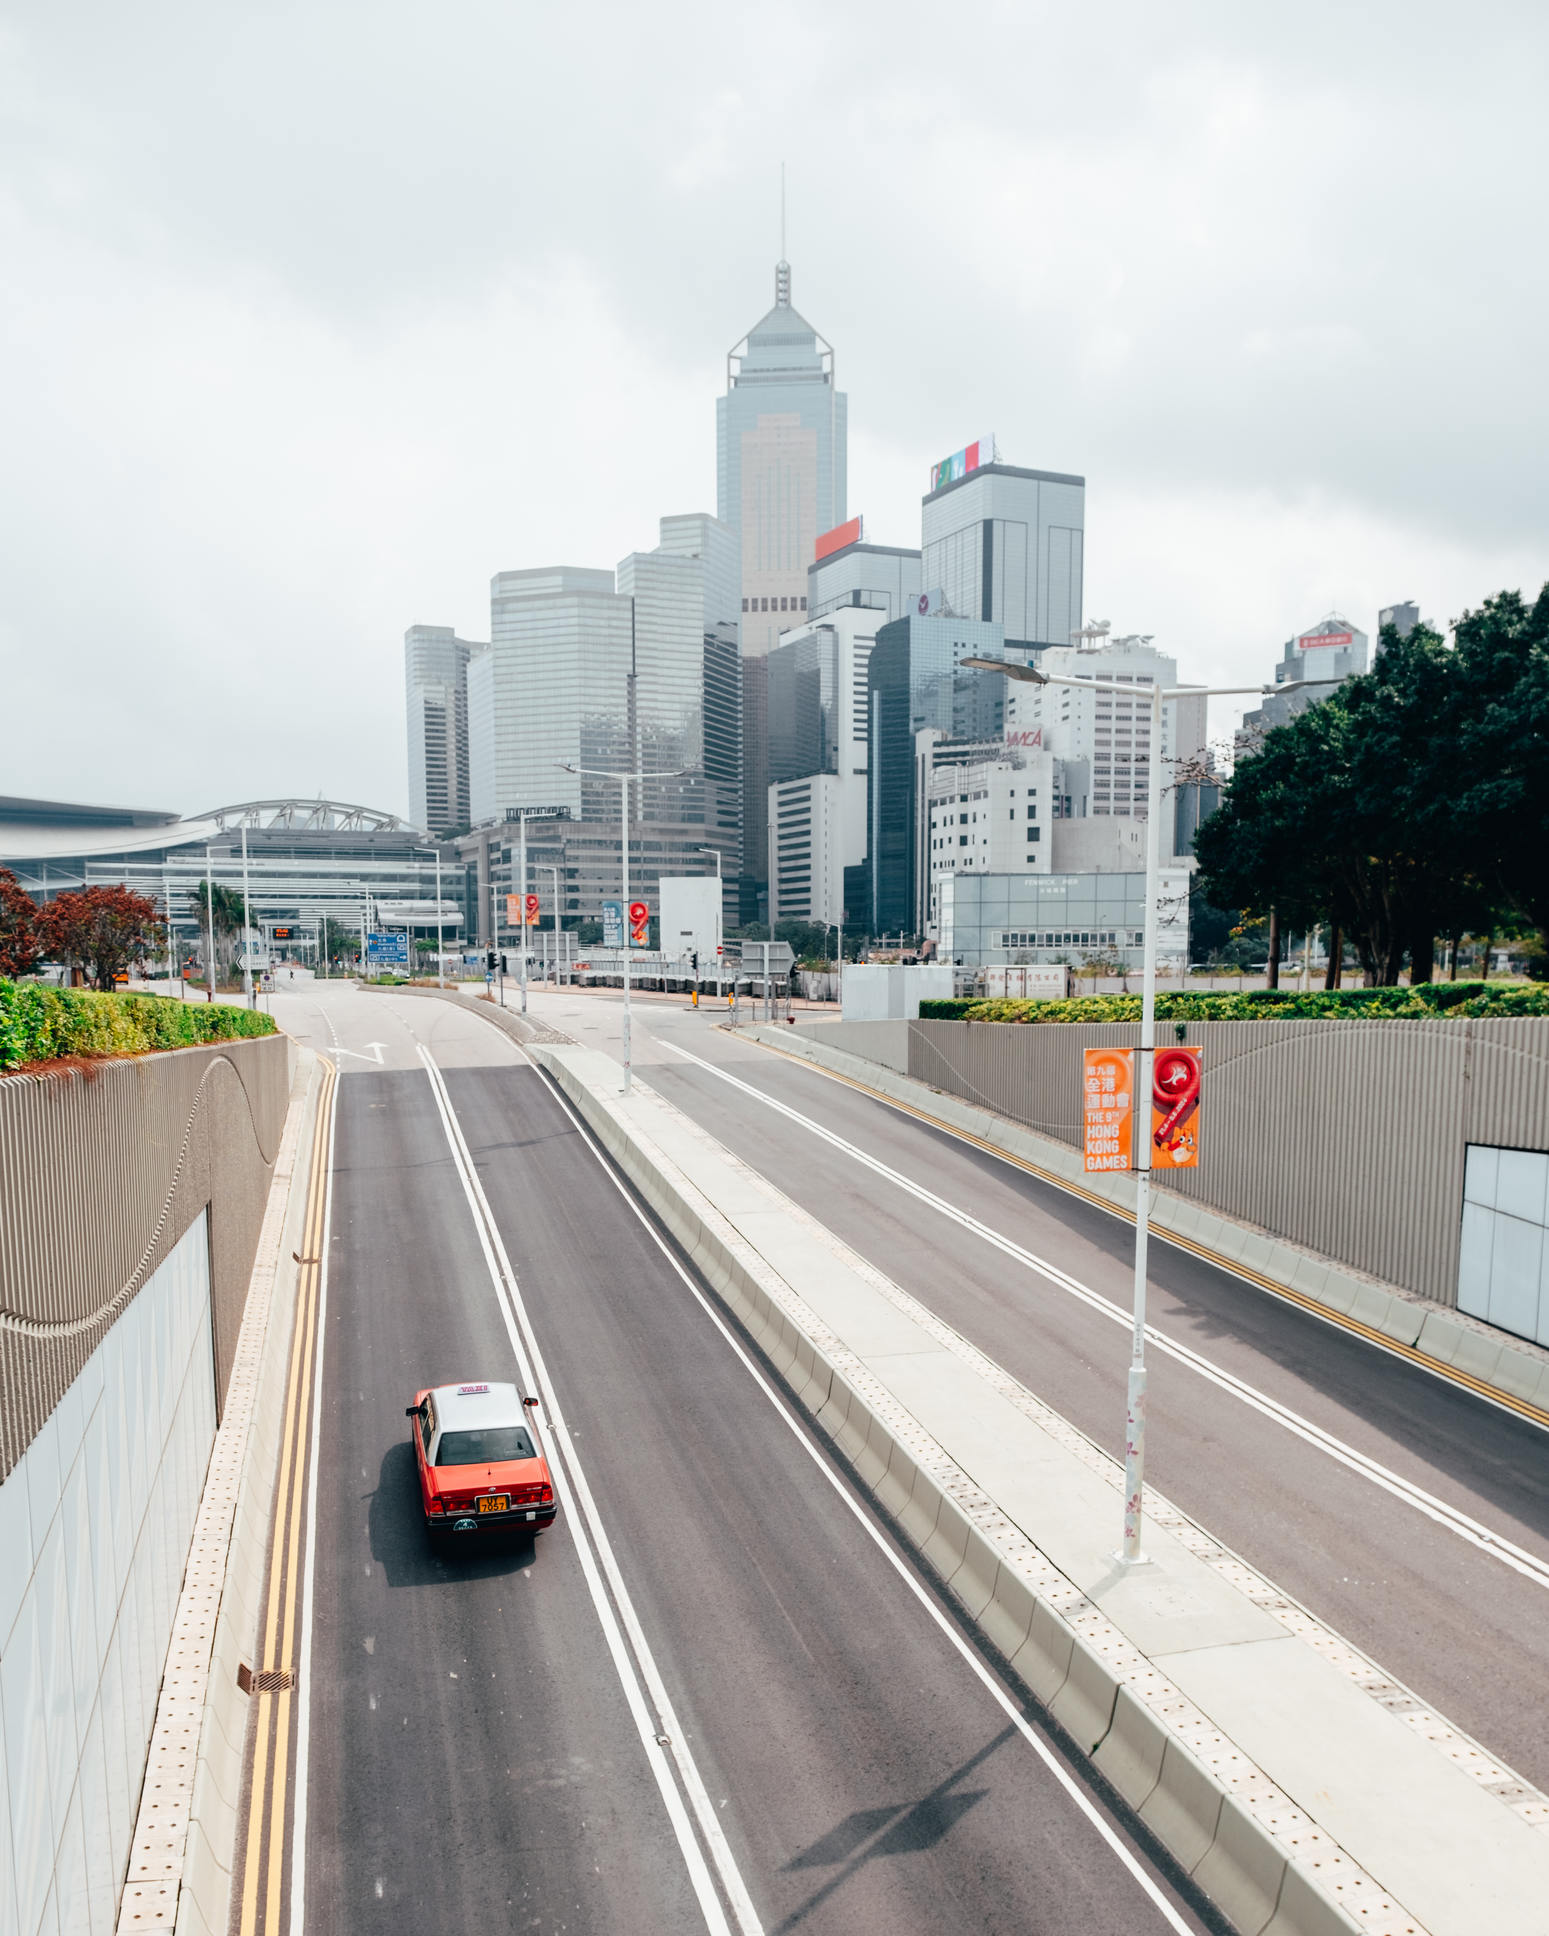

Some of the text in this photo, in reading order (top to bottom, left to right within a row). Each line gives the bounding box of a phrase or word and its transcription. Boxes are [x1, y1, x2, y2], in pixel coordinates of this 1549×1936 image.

[1087, 1113, 1105, 1123] THE
[1087, 1124, 1119, 1139] HONG
[1087, 1140, 1119, 1154] KONG
[1087, 1155, 1128, 1171] GAMES
[481, 1503, 504, 1512] 7057
